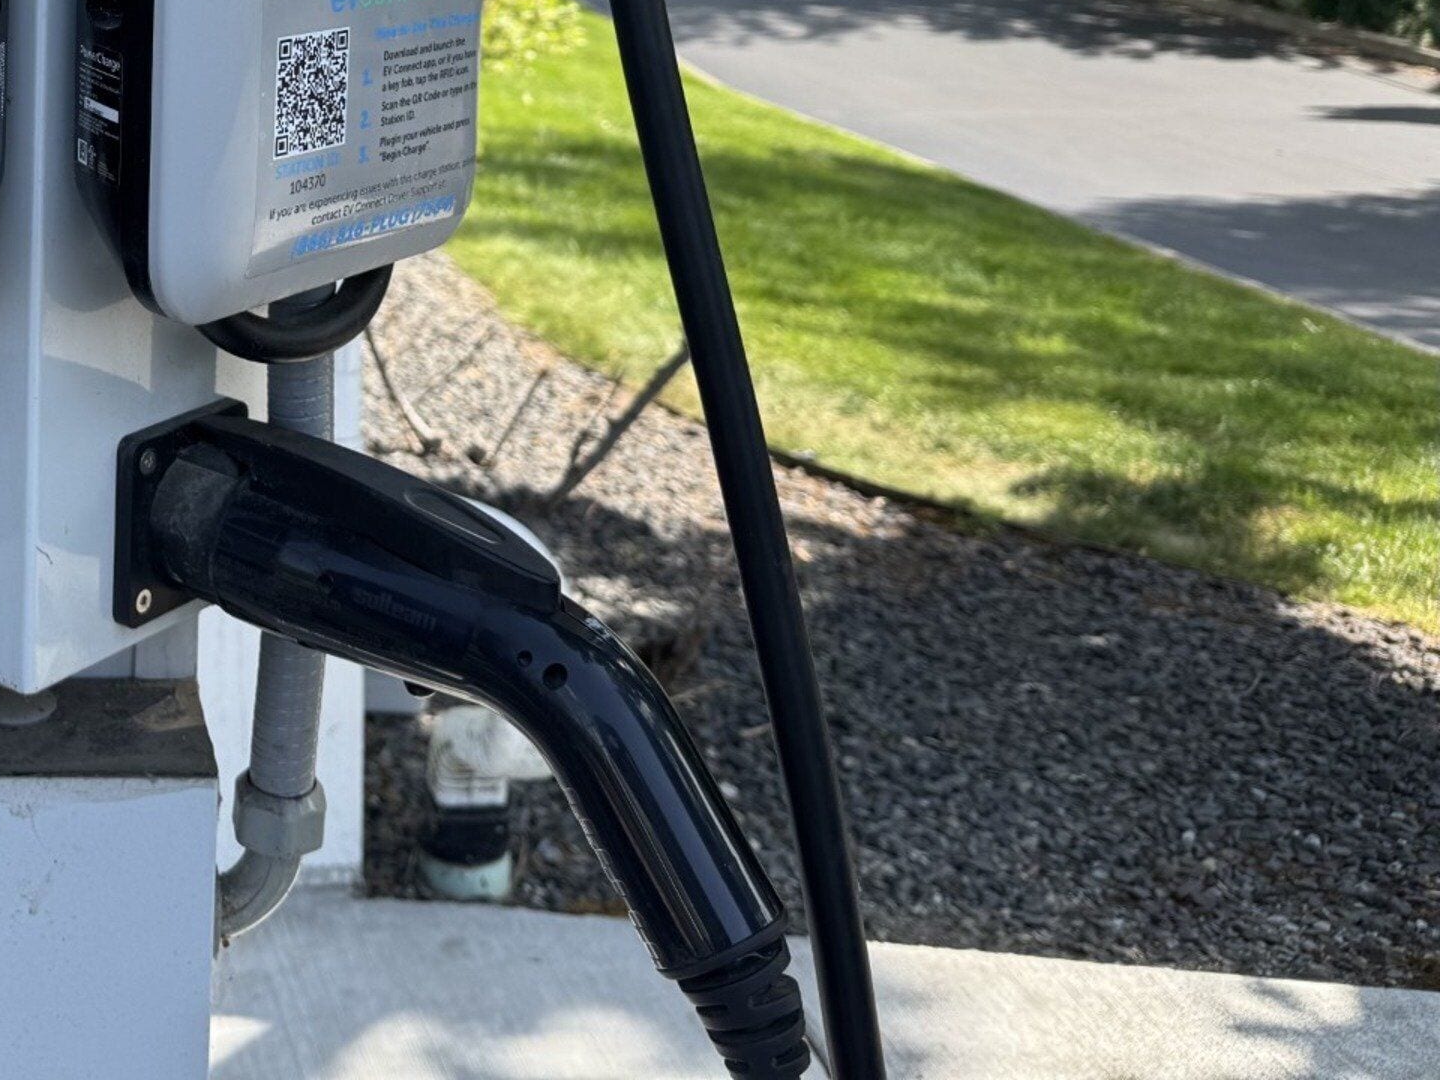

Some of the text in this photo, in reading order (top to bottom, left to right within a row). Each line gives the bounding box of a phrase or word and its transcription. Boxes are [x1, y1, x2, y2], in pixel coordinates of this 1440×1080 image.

[384, 36, 466, 61] Download and launch the
[383, 65, 392, 77] EV
[393, 60, 422, 74] Connect
[438, 56, 445, 65] or
[452, 52, 464, 65] you
[388, 79, 400, 92] key
[415, 74, 427, 86] tap
[428, 72, 438, 82] the
[381, 99, 398, 112] Scan
[399, 96, 411, 108] the
[412, 92, 423, 104] QR
[423, 89, 441, 102] Code
[441, 88, 449, 97] or
[449, 85, 463, 98] type
[381, 112, 405, 126] Station
[379, 117, 470, 148] Plugin your vehicle and press
[269, 207, 275, 220] If
[276, 204, 292, 221] you
[293, 200, 306, 213] are
[308, 187, 358, 210] experiencing
[359, 182, 380, 197] issues
[382, 178, 398, 193] with
[399, 174, 413, 187] this
[413, 167, 437, 184] charge
[290, 174, 326, 195] 104370
[312, 209, 341, 225] contact
[343, 205, 354, 217] EV
[356, 196, 385, 213] Connect
[388, 189, 409, 205] Driver
[411, 182, 436, 199] Support
